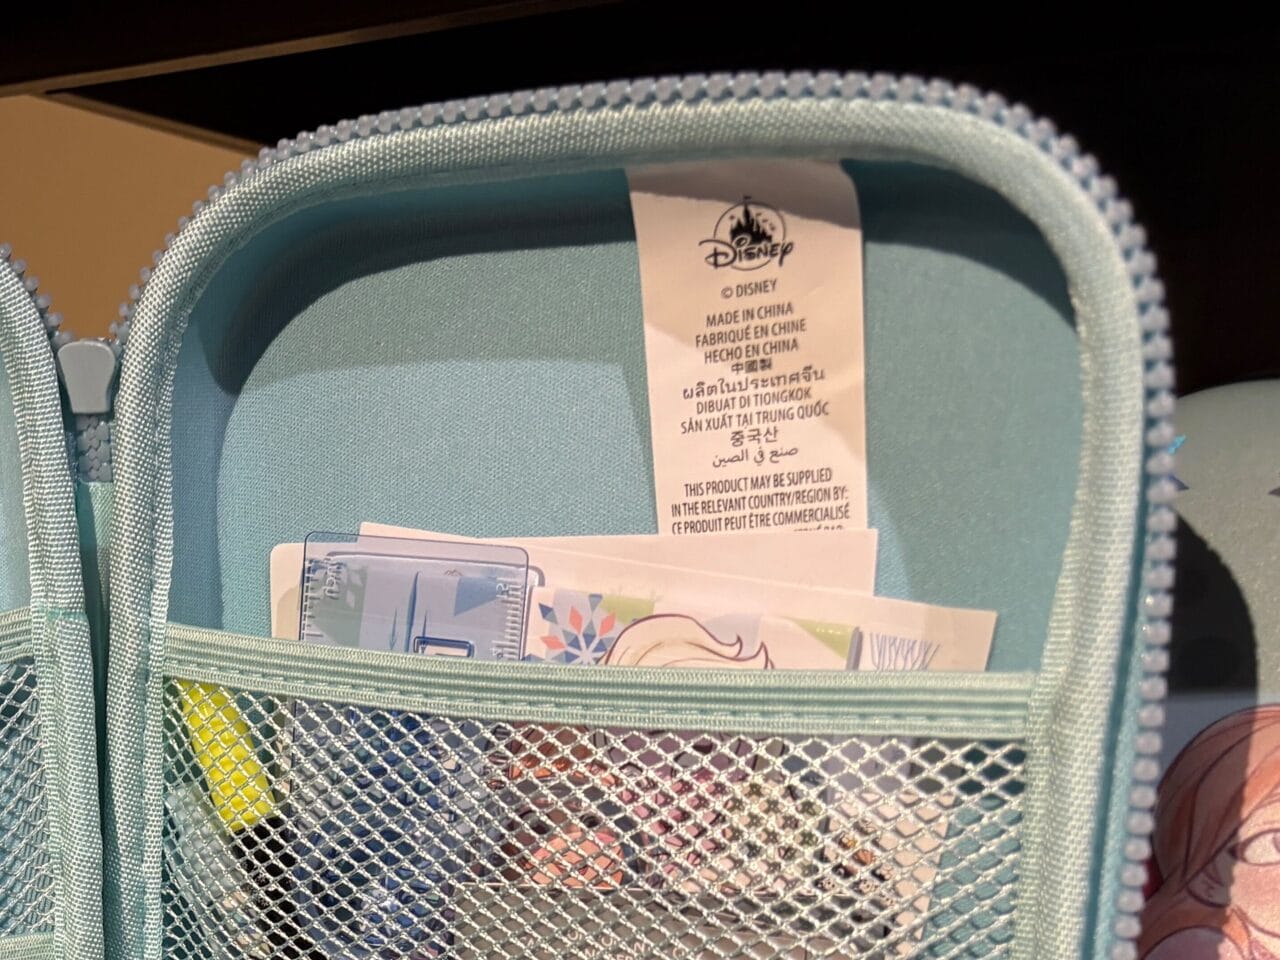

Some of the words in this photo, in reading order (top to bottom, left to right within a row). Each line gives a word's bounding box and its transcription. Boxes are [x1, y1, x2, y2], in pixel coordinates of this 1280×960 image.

[735, 279, 777, 298] DISNEY
[706, 310, 740, 327] MADE
[742, 308, 755, 321] IN
[757, 301, 794, 320] CHINA
[695, 324, 751, 348] FABRIQUÉ
[753, 324, 768, 339] EN
[771, 318, 807, 337] CHINE
[704, 346, 743, 364] HECHO
[745, 344, 760, 358] EN
[762, 338, 799, 356] CHINA
[682, 365, 825, 400] ผลิตในประเทศจีน
[696, 396, 736, 415] DIBUAT
[740, 395, 751, 409] DI
[754, 386, 812, 407] TIONGKOK
[736, 412, 753, 430] TẠI
[755, 407, 794, 425] TRUNG
[730, 425, 779, 448] 중국산
[712, 448, 749, 468] الصين
[753, 446, 765, 466] في
[769, 446, 799, 464] صنع
[684, 482, 705, 498] THIS
[706, 477, 749, 495] PRODUCT
[750, 473, 771, 490] MAY
[773, 472, 785, 487] BE
[786, 467, 833, 486] SUPPLIED
[671, 504, 681, 518] IN
[682, 502, 700, 516] THE
[701, 496, 747, 514] RELEVANT
[748, 487, 831, 510] COUNTRY/REGION
[832, 485, 849, 501] BY:
[671, 521, 683, 535] CE
[684, 517, 722, 534] PRODUIT
[724, 516, 747, 532] PEUT
[749, 512, 771, 529] ÊTRE
[772, 503, 851, 527] COMMERCIALISÉ
